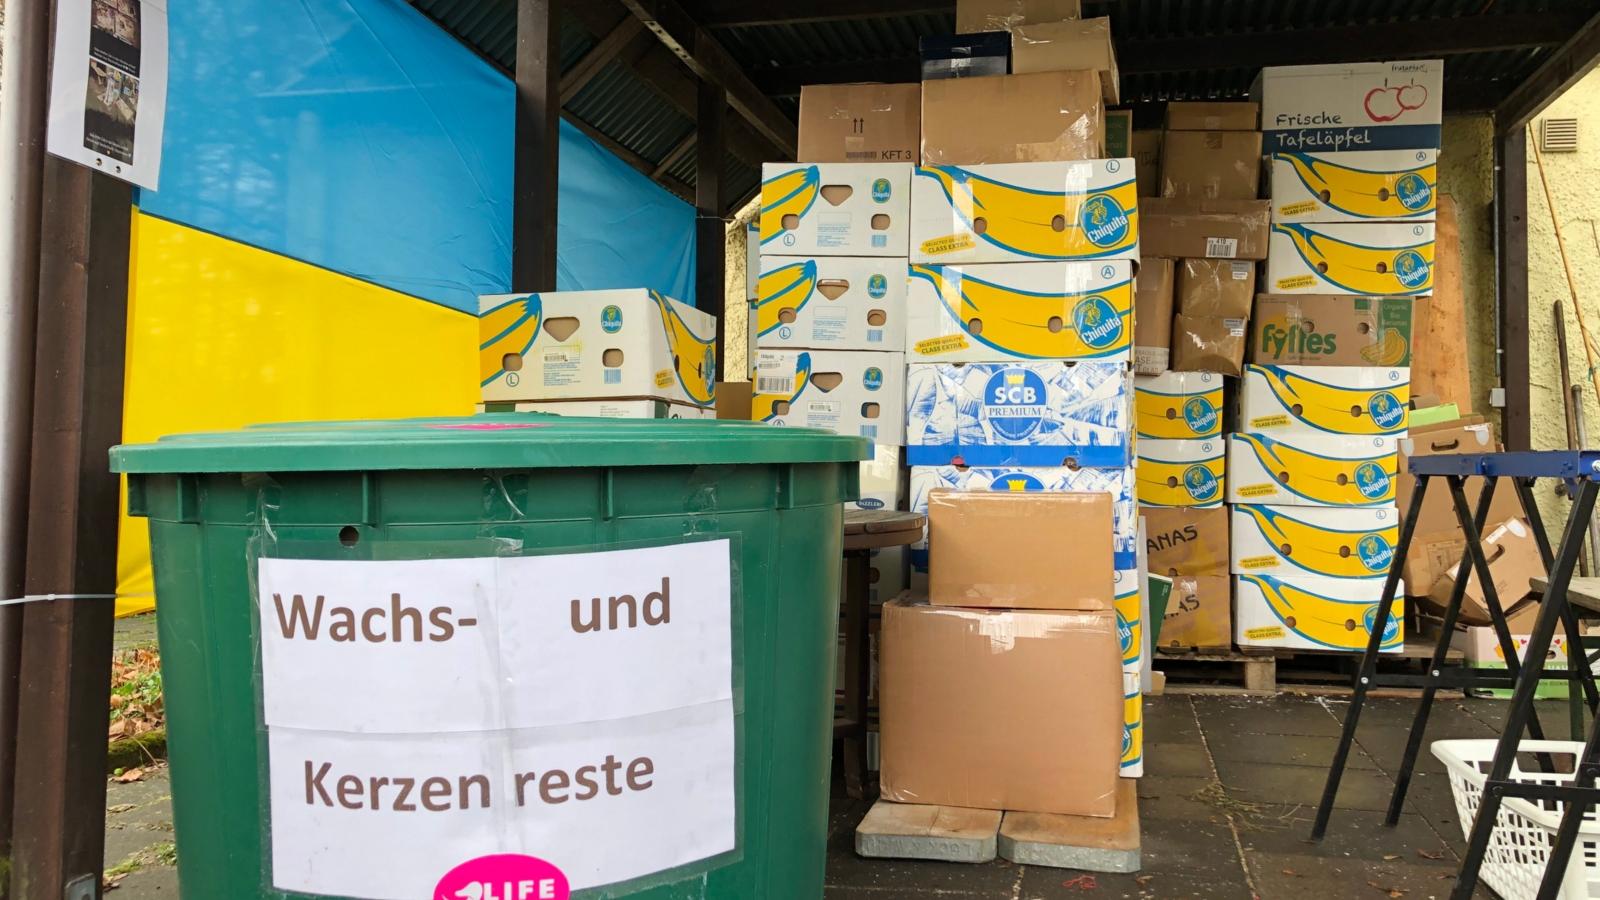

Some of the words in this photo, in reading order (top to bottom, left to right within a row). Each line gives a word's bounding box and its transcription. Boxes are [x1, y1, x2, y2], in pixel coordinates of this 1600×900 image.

[1276, 111, 1342, 126] Frische
[1276, 127, 1371, 152] Tafeläpfel
[881, 151, 902, 160] KFT
[905, 151, 911, 160] 3
[1087, 214, 1129, 244] Chiquita
[928, 246, 948, 254] CLASS
[949, 242, 968, 250] EXTRA
[1400, 265, 1429, 285] Chiquita
[1081, 315, 1121, 344] Chiquita
[921, 346, 940, 354] CLASS
[941, 343, 962, 351] EXTRA
[994, 386, 1037, 404] SCB
[988, 407, 1041, 417] PREMIUM
[1189, 411, 1217, 429] Chiquita
[1374, 406, 1403, 425] Chiquita
[1189, 479, 1217, 497] Chiquita
[1360, 476, 1390, 496] Chiquita
[272, 593, 477, 643] Wachs-
[570, 576, 671, 633] und
[305, 760, 490, 811] Kerzen
[514, 754, 654, 807] reste
[483, 878, 555, 900] LIFE
